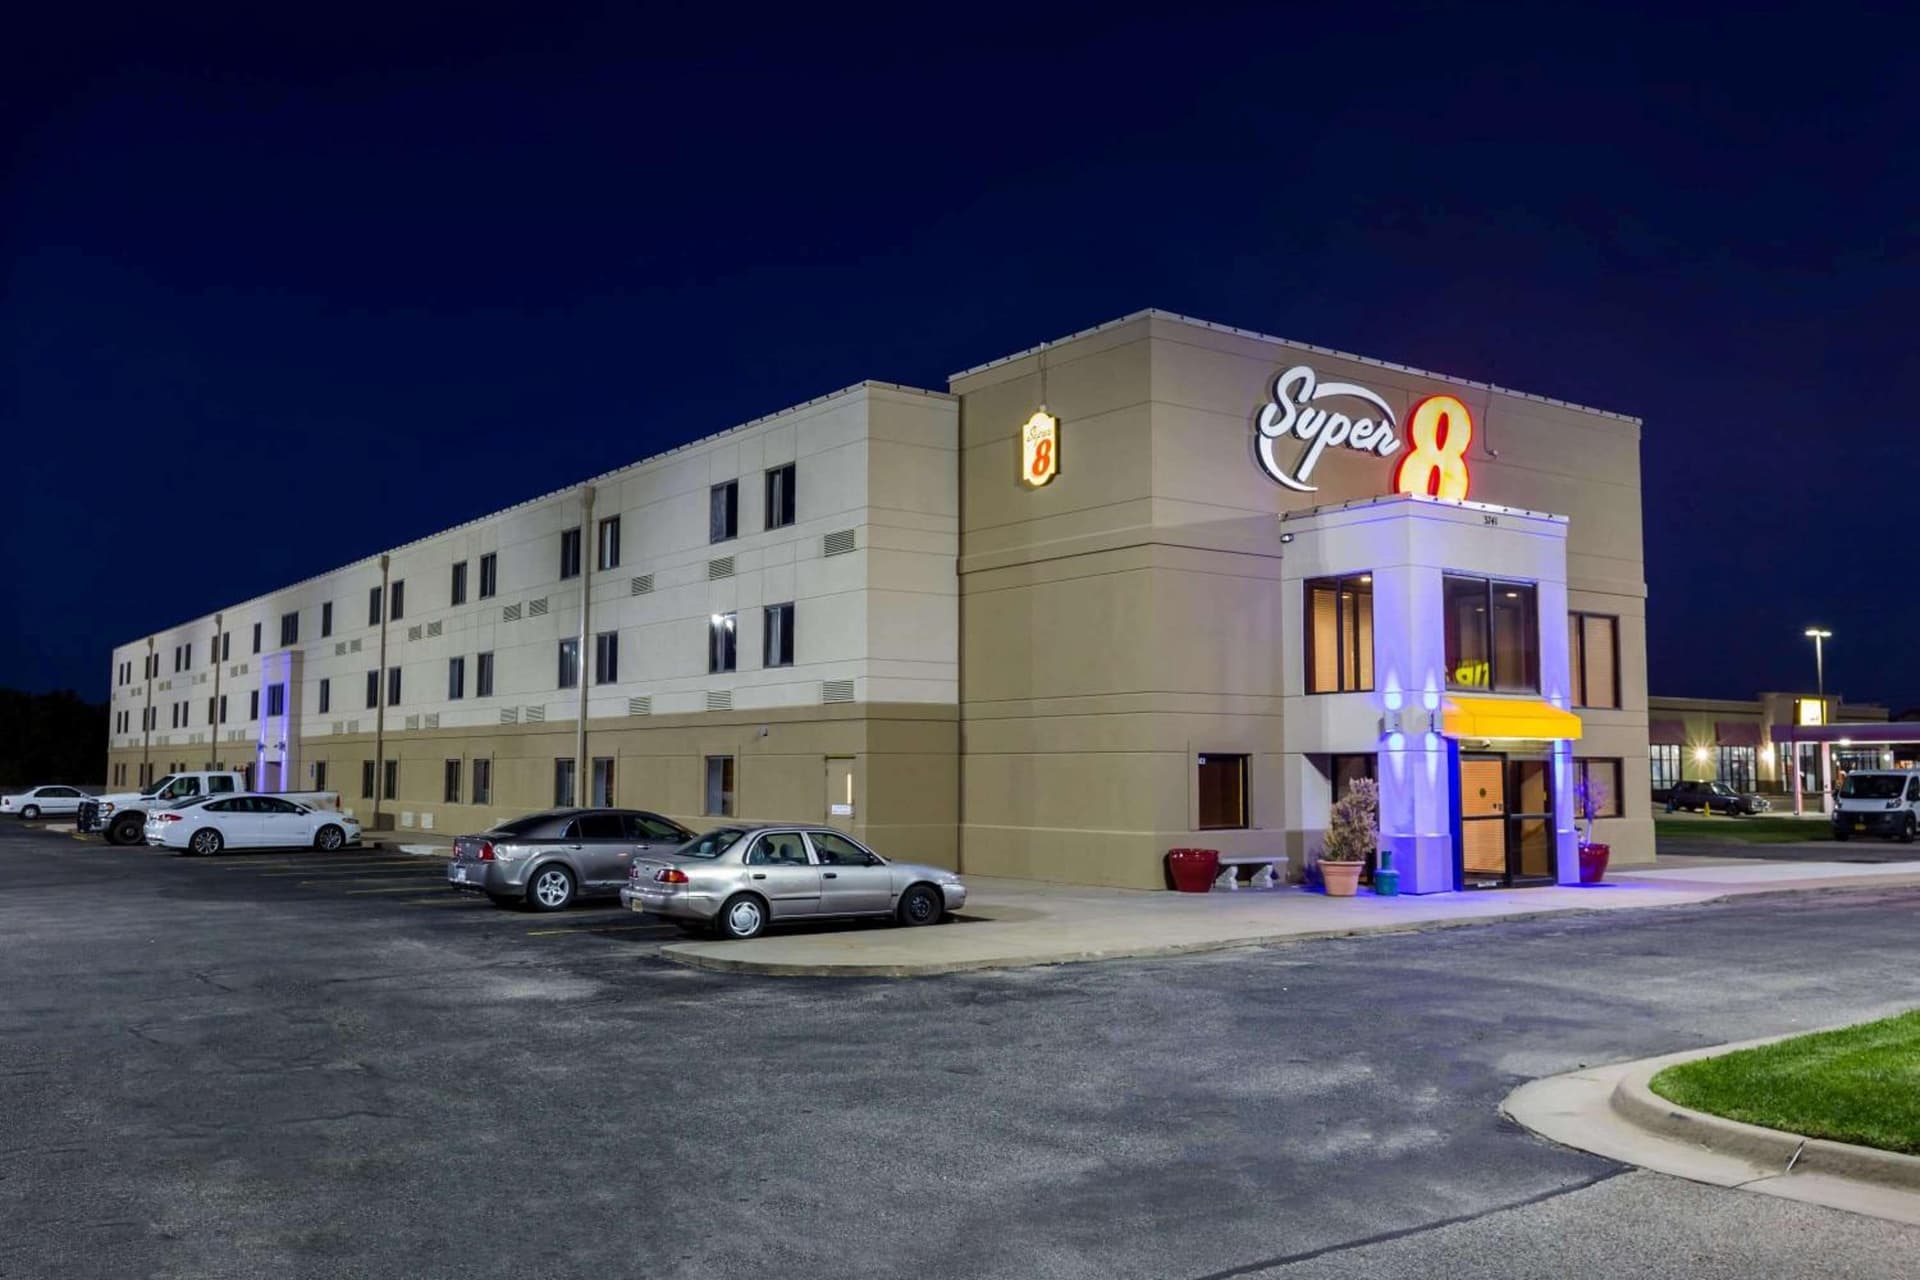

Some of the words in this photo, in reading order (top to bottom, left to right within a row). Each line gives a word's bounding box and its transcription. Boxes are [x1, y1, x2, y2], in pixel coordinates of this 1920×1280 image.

[1032, 438, 1051, 476] 8
[1259, 364, 1402, 486] Super
[1394, 394, 1473, 501] 8
